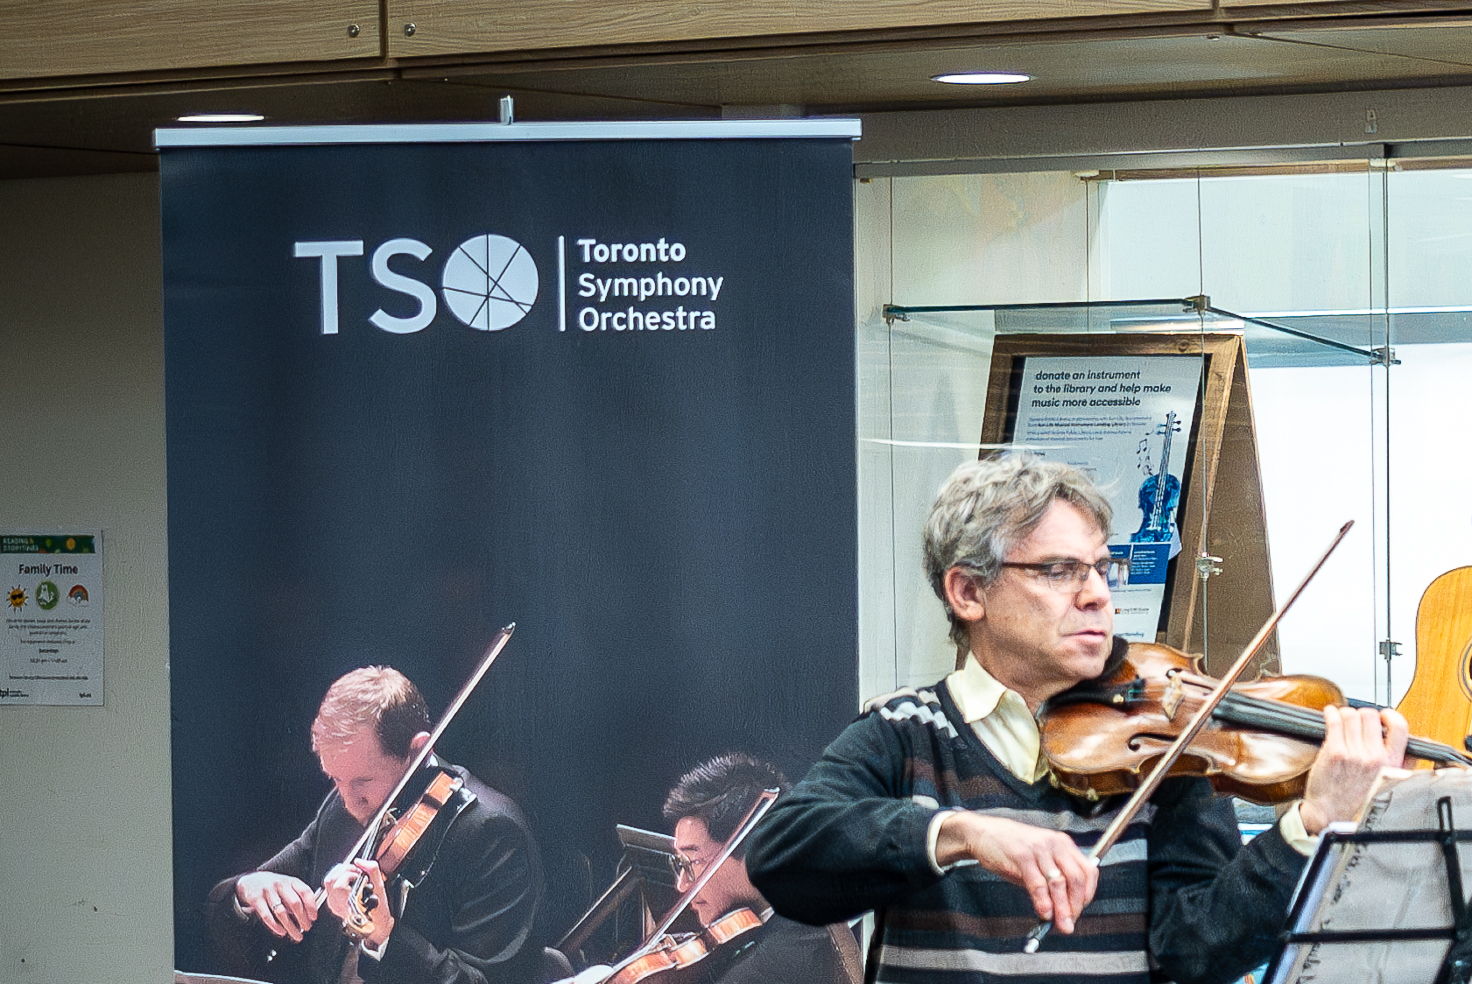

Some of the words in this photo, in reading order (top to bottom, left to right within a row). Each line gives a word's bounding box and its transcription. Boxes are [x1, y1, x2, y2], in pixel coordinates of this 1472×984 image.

[577, 238, 686, 263] Toronto
[293, 233, 539, 335] TSO
[577, 273, 724, 302] Symphony
[578, 306, 716, 332] Orchestra
[1035, 370, 1070, 381] donate
[1072, 372, 1085, 380] an
[1087, 370, 1141, 380] instrument
[1033, 385, 1044, 394] to
[1045, 384, 1061, 393] the
[1063, 383, 1096, 395] library
[1098, 384, 1117, 393] and
[1119, 383, 1141, 394] help
[1143, 383, 1172, 393] make
[1031, 397, 1060, 408] music
[1062, 399, 1087, 407] more
[1089, 396, 1141, 407] accessible
[18, 564, 52, 577] Family
[53, 564, 79, 575] Time
